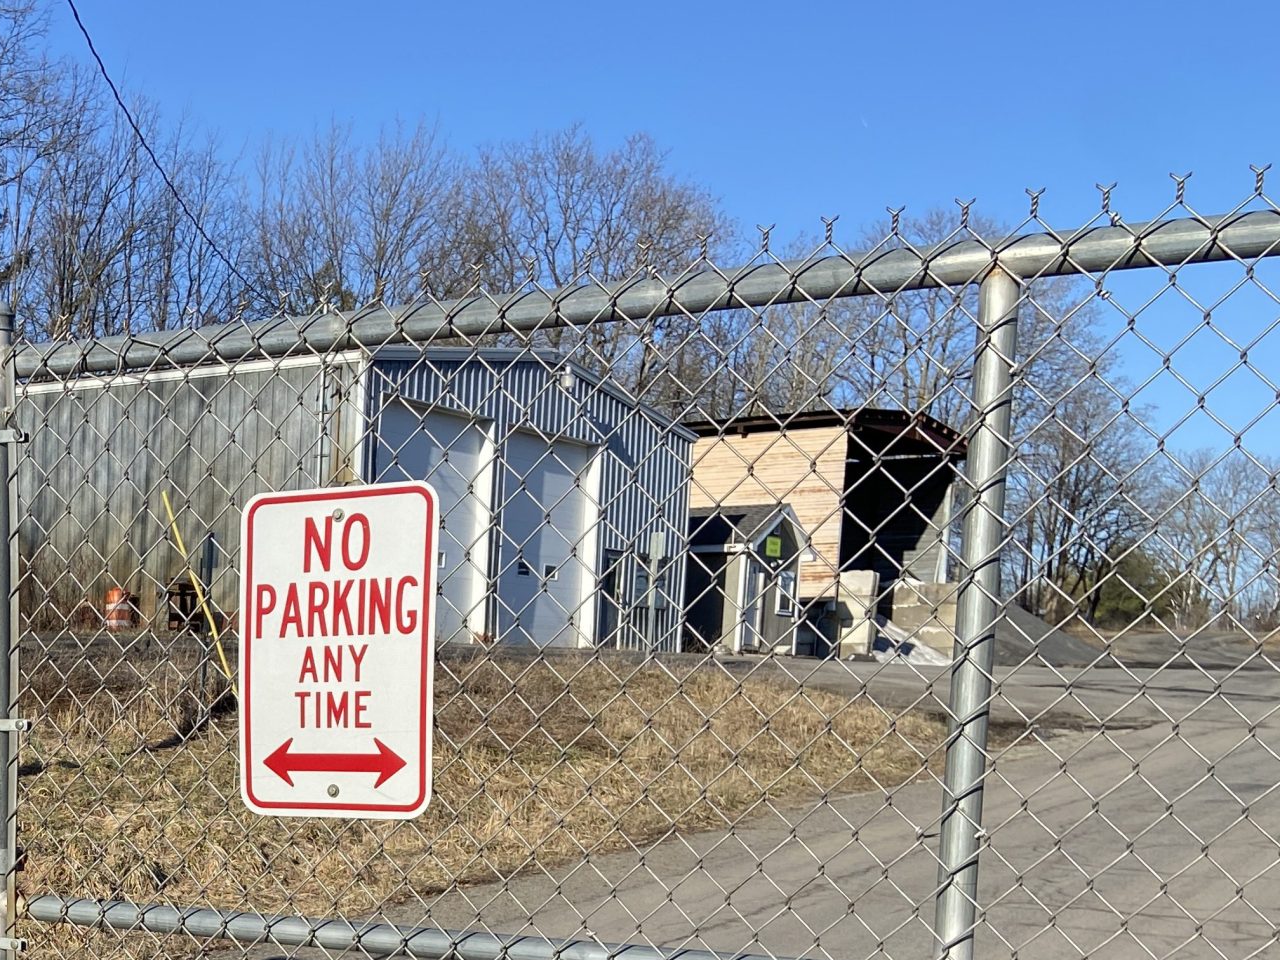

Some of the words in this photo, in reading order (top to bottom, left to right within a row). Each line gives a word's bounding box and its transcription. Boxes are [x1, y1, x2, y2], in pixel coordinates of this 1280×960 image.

[303, 513, 371, 573] NO
[255, 575, 419, 639] PARKING
[298, 644, 369, 683] ANY
[294, 690, 372, 729] TIME
